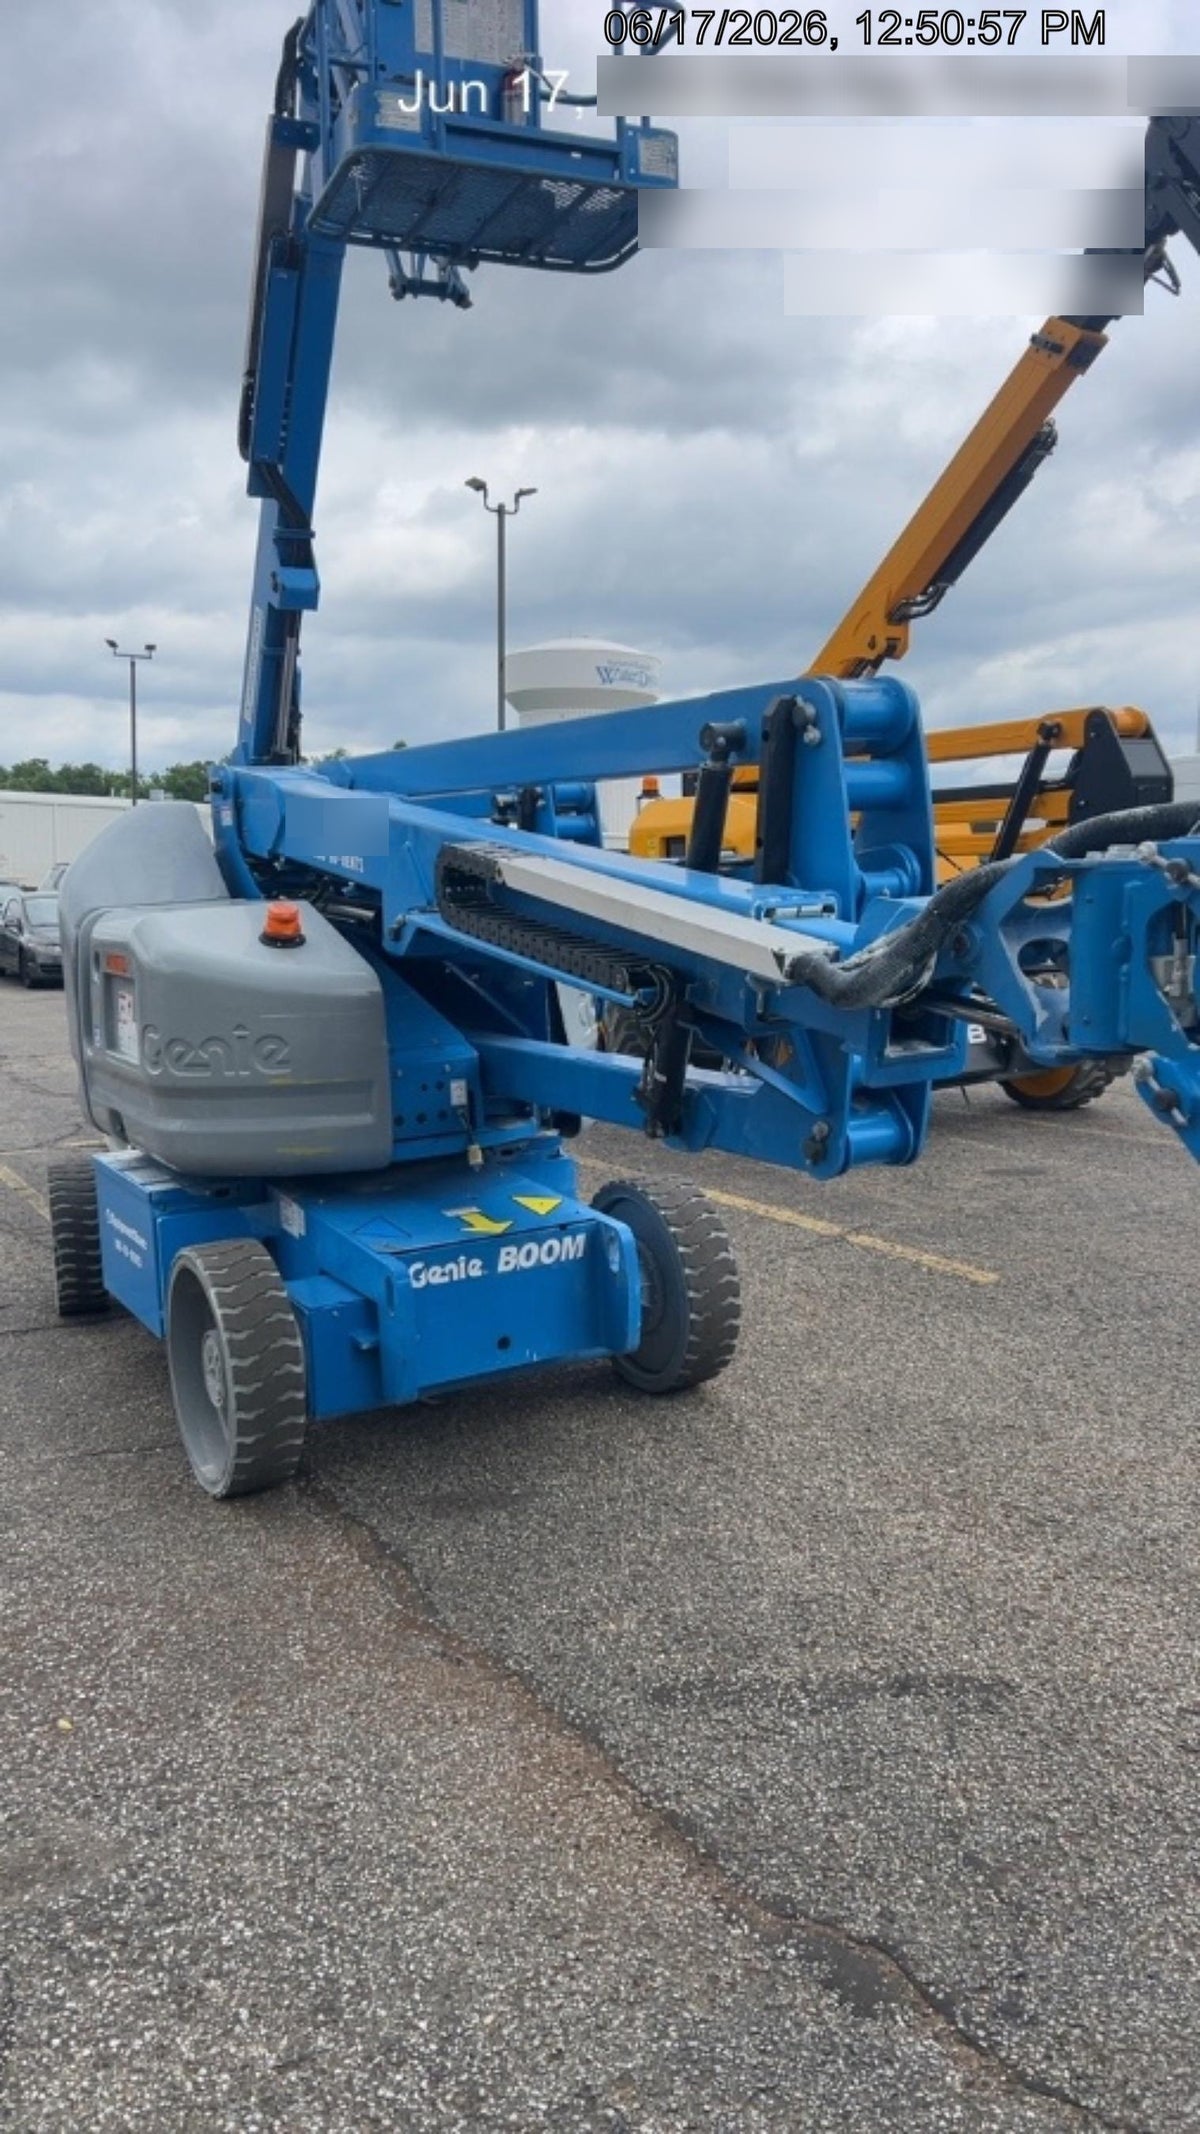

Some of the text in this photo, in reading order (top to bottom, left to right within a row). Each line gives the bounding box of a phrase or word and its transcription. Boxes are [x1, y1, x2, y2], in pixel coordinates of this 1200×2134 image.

[142, 1023, 293, 1077] Genie
[408, 1233, 587, 1288] Genie BOOM
